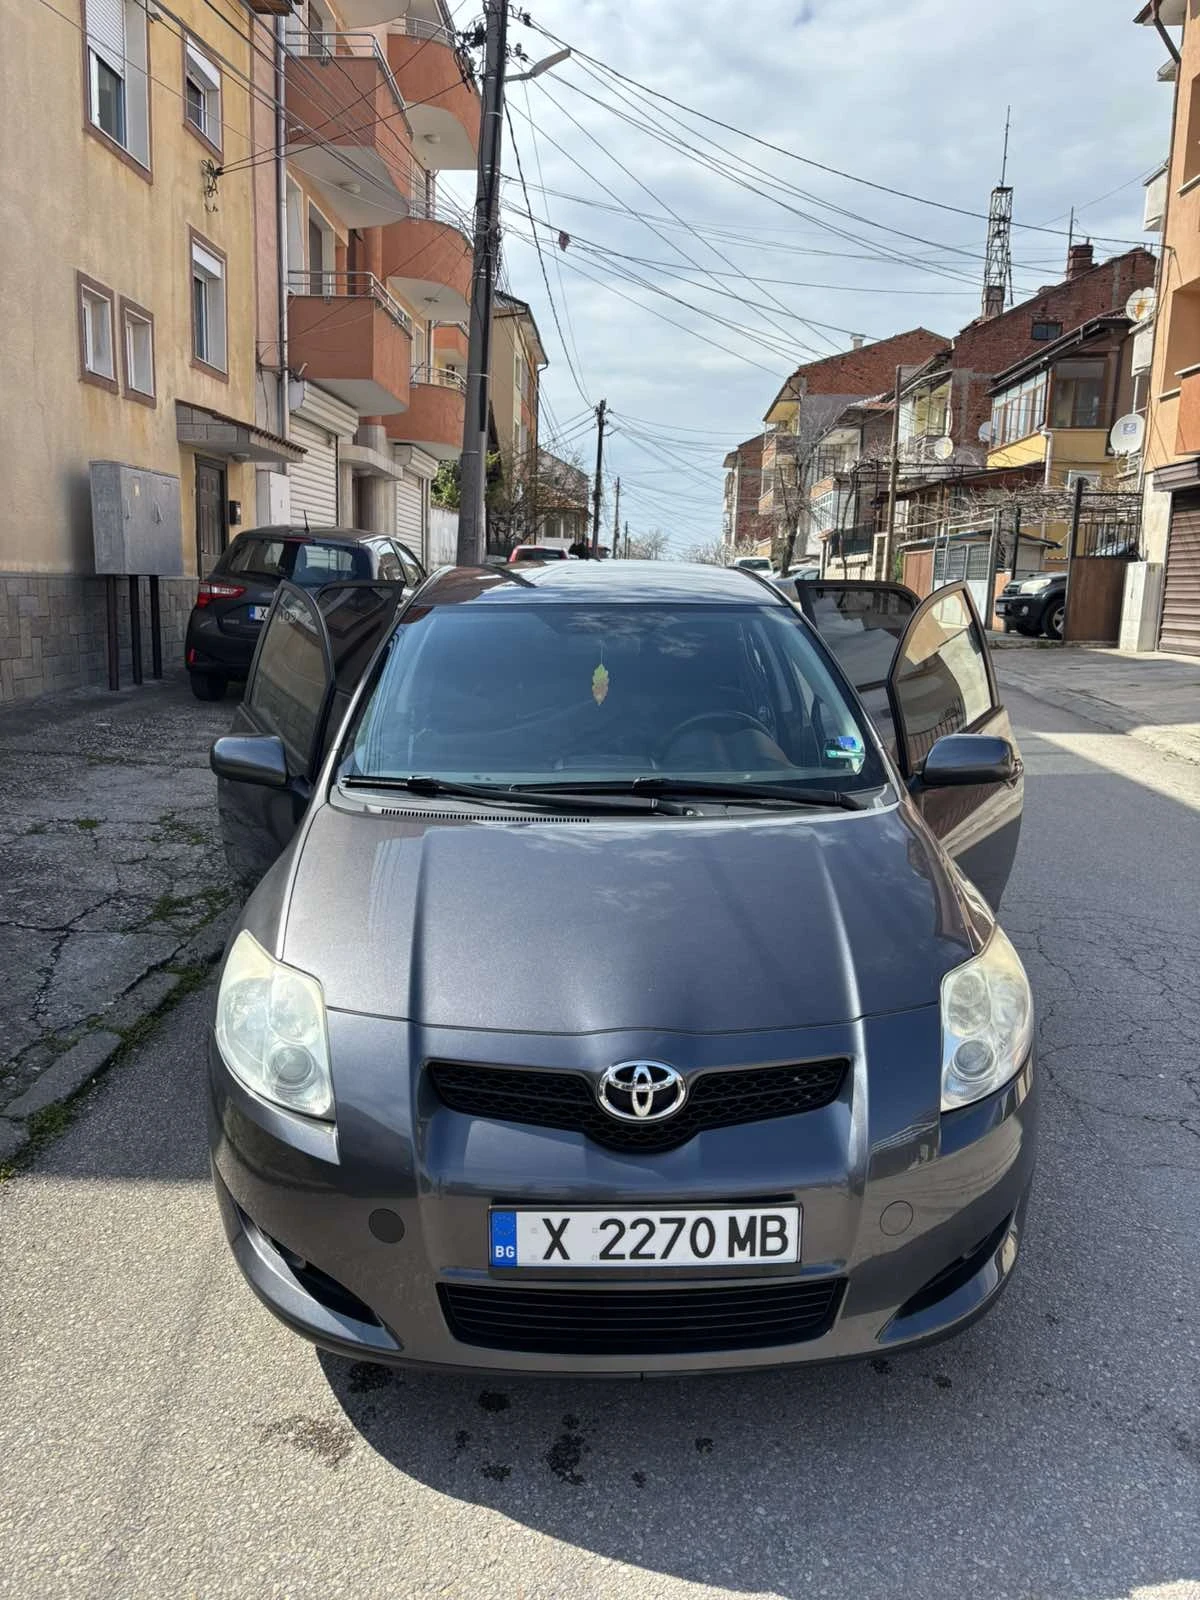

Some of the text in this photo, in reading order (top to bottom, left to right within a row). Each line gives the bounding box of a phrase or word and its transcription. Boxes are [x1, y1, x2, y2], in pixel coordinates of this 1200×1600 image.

[260, 608, 266, 619] X
[543, 1215, 788, 1260] X 2270 MB
[495, 1245, 515, 1258] BG
